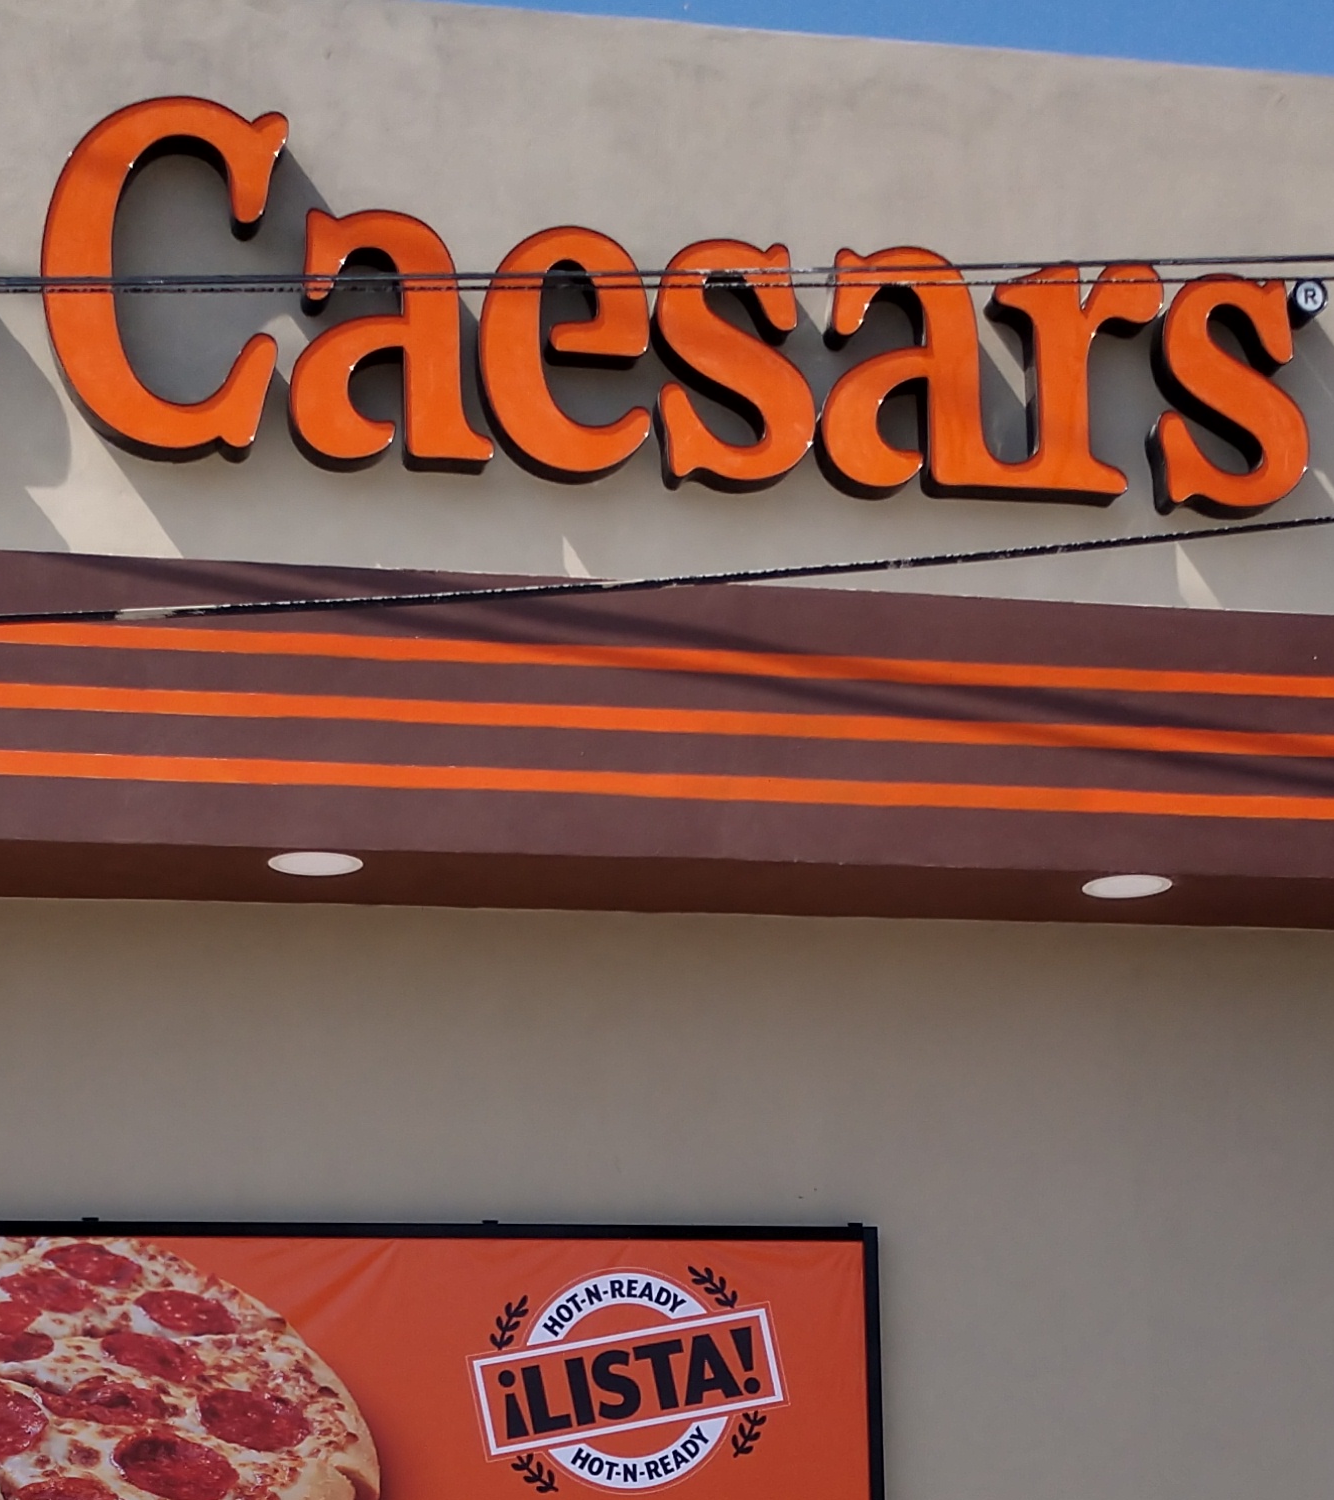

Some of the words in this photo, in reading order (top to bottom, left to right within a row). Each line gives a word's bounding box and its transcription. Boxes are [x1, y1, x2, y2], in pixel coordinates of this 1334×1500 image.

[41, 95, 1313, 516] Caesars
[542, 1278, 687, 1338] HOT-N-READY
[498, 1326, 762, 1441] ¡LISTA!
[571, 1426, 711, 1483] HOT-N-READY
